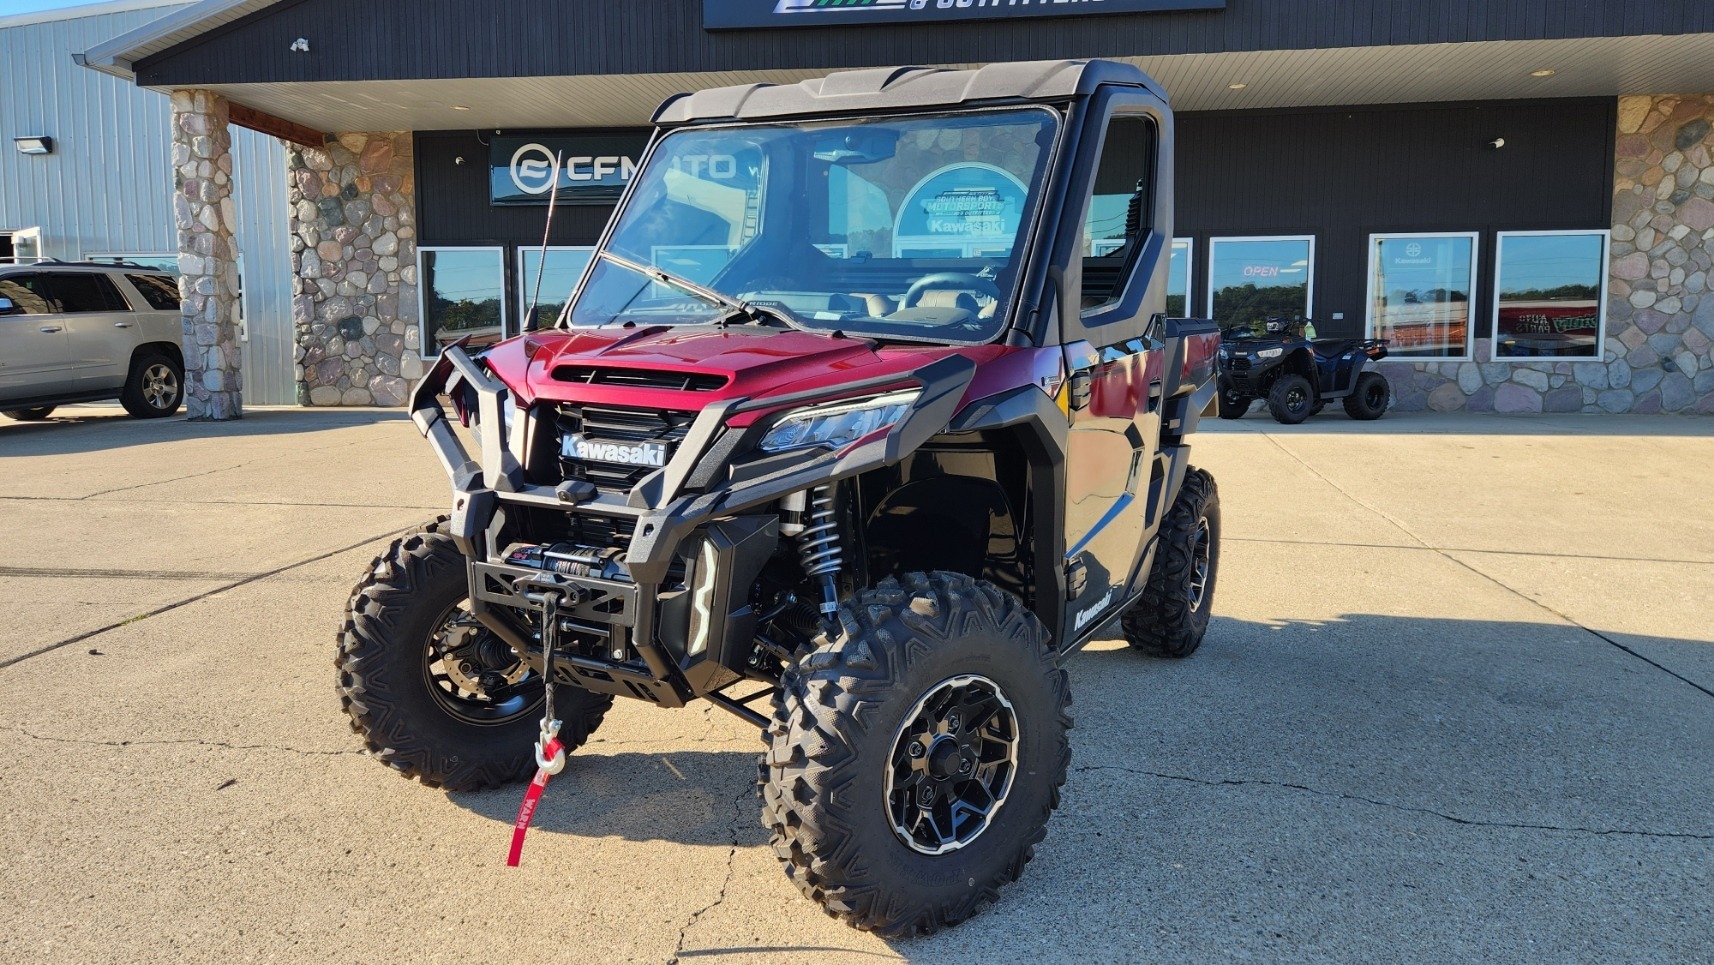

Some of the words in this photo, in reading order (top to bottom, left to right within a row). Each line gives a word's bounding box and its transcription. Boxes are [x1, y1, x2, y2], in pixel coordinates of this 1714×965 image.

[931, 219, 1005, 232] Kawasaki
[1243, 265, 1278, 277] OPEN
[561, 435, 666, 466] Kawasaki
[1074, 588, 1113, 631] Kawasaki
[516, 798, 536, 830] WARN
